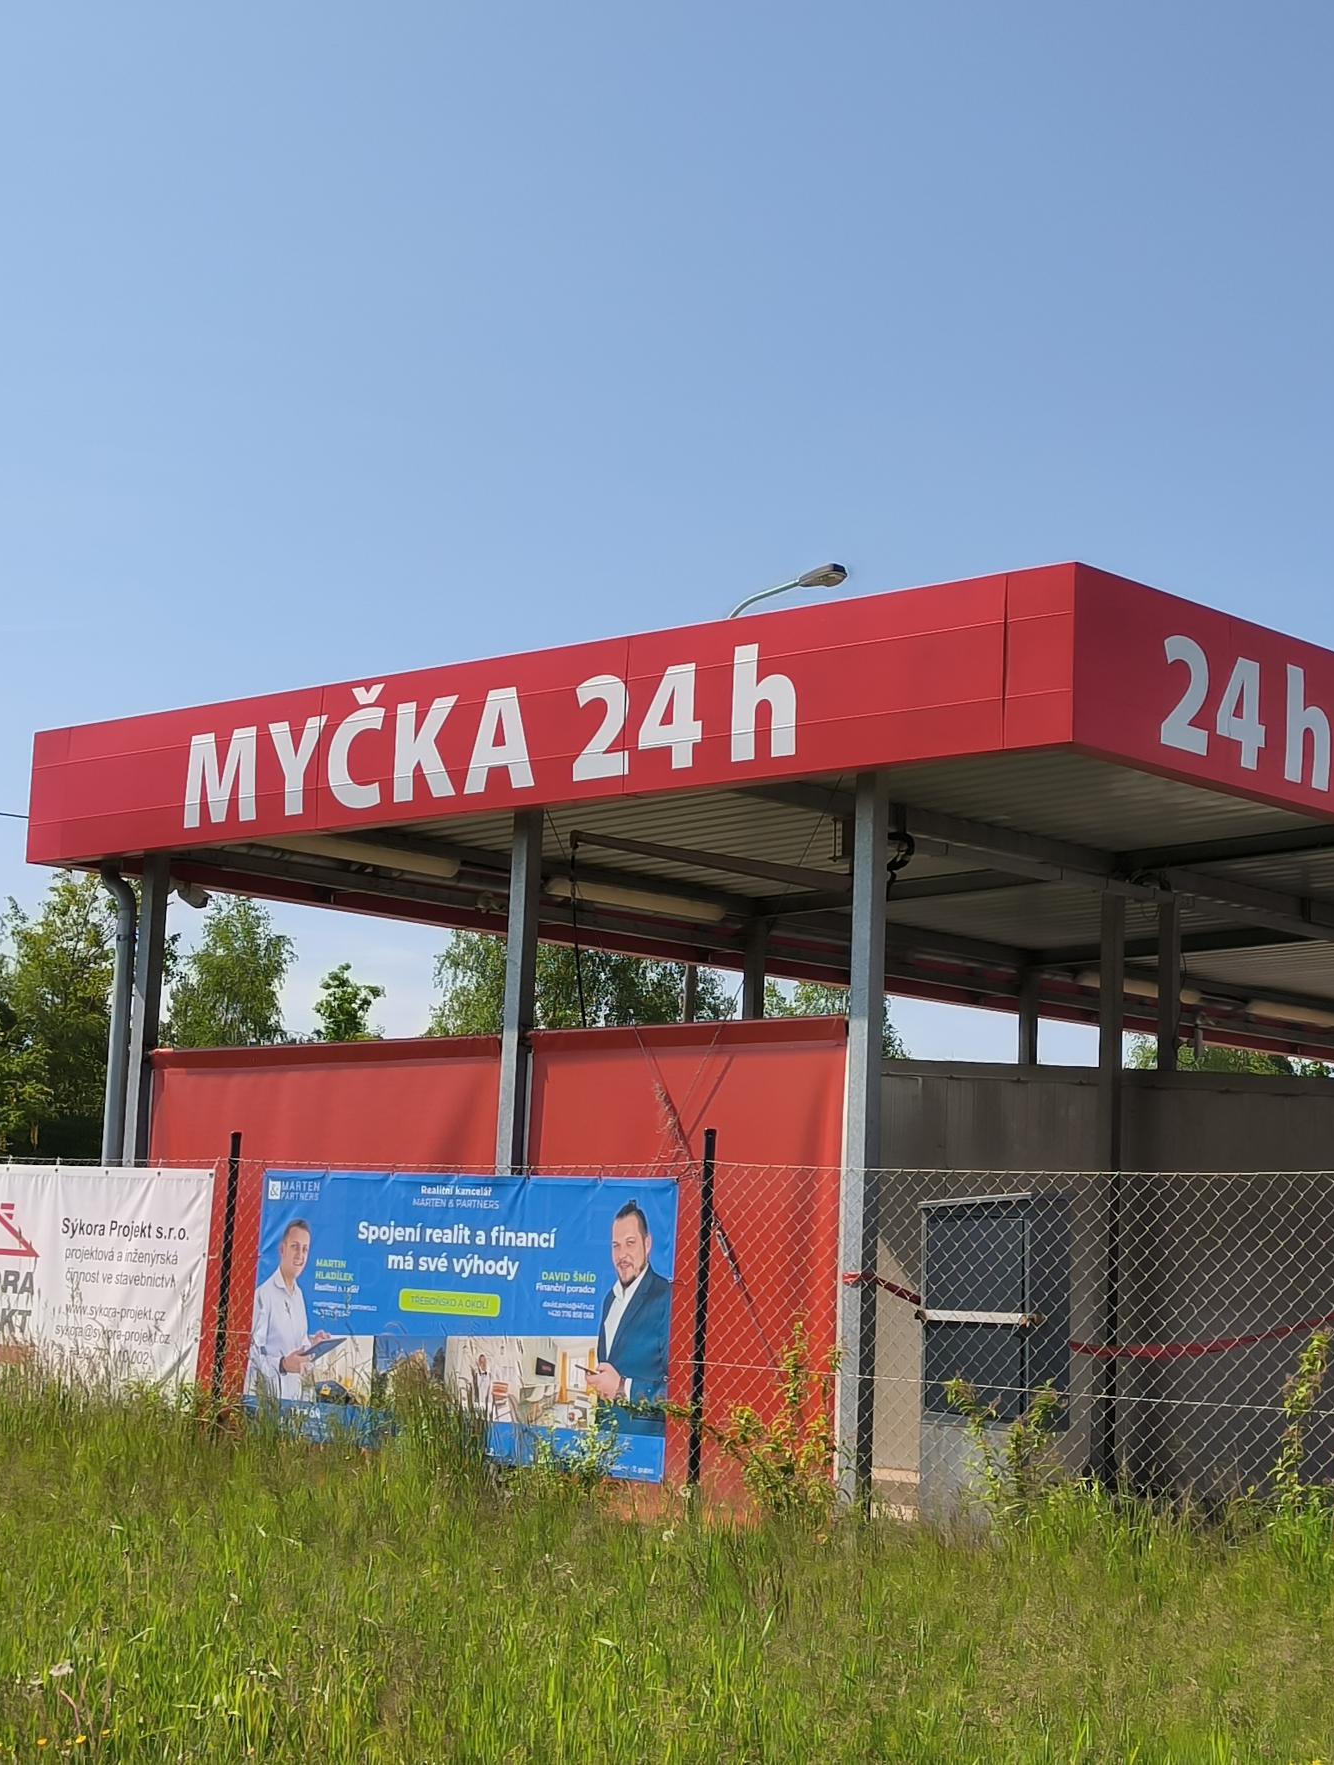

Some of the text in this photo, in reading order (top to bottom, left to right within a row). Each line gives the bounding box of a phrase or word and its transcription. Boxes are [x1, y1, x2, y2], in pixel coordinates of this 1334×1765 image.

[1161, 635, 1331, 792] 24 h
[184, 643, 797, 829] MYČKA 24 h
[282, 1181, 321, 1192] MARTEN
[421, 1185, 493, 1197] Realitní kancelář
[281, 1191, 320, 1201] PARTNERS
[412, 1198, 447, 1208] MARTEN
[456, 1199, 500, 1210] PARTNERS
[61, 1217, 189, 1242] Sýkora Projekt s.r.o.
[358, 1221, 557, 1249] Spojení realit a financí
[64, 1245, 178, 1267] projektová a inženýrská
[315, 1258, 347, 1269] MARTIN
[387, 1251, 520, 1280] má své výhody
[102, 1272, 113, 1284] ve
[541, 1270, 597, 1283] DAVID ŠMÍD
